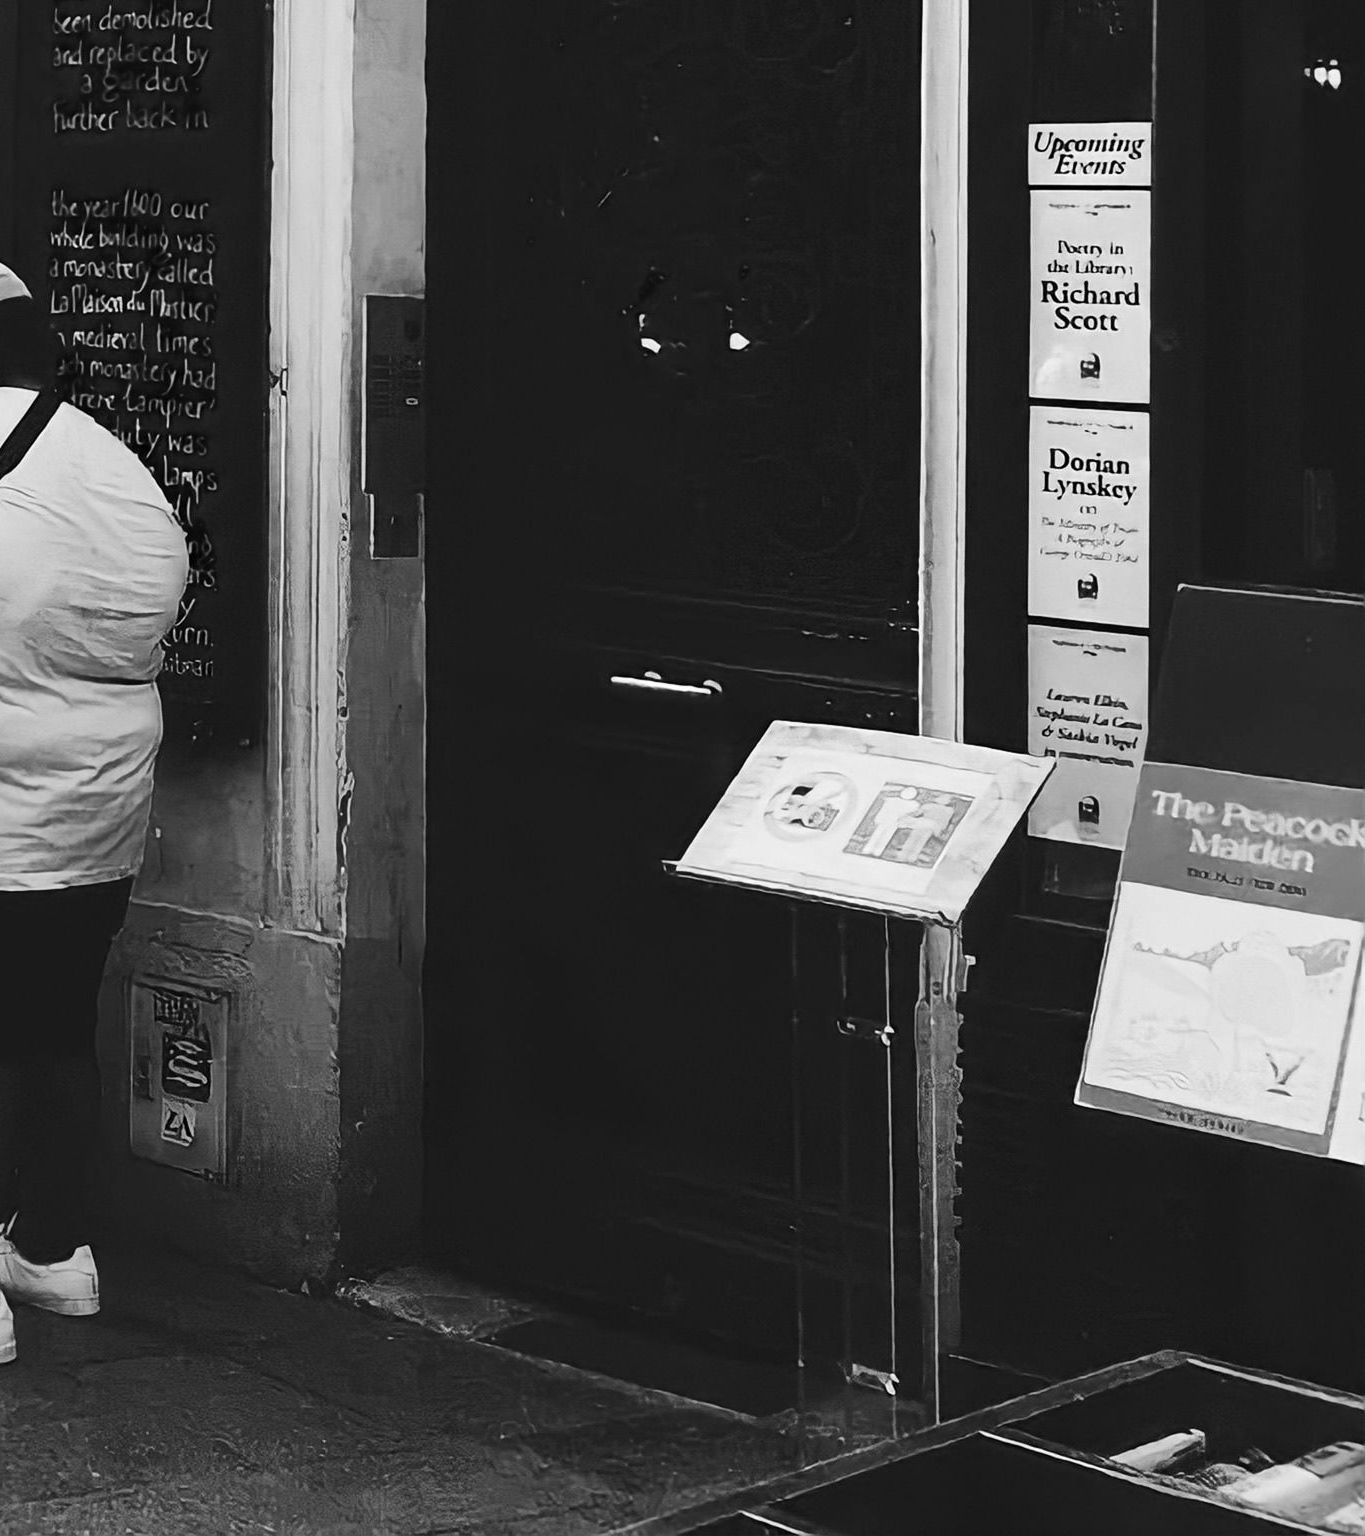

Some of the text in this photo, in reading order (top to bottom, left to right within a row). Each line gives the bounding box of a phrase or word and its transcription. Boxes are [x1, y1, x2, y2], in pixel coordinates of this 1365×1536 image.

[53, 8, 91, 34] been
[90, 34, 177, 76] replaced
[187, 36, 209, 77] by
[81, 74, 92, 93] a
[186, 110, 209, 128] in
[1034, 131, 1145, 160] Upcoming
[1054, 153, 1126, 175] Events
[52, 190, 77, 216] the
[83, 199, 119, 224] year
[170, 202, 209, 220] our
[99, 223, 169, 258] building
[177, 233, 216, 254] was
[49, 252, 214, 293] a monastery called
[127, 290, 145, 311] du
[1041, 280, 1139, 305] Richard
[1054, 306, 1118, 331] Scott
[72, 322, 145, 351] medieval
[182, 358, 215, 390] had
[169, 434, 207, 455] was
[1049, 448, 1130, 474] Dorian
[1042, 470, 1137, 506] Lynskey
[1152, 789, 1365, 848] The Peacock
[1188, 827, 1314, 873] Maiden
